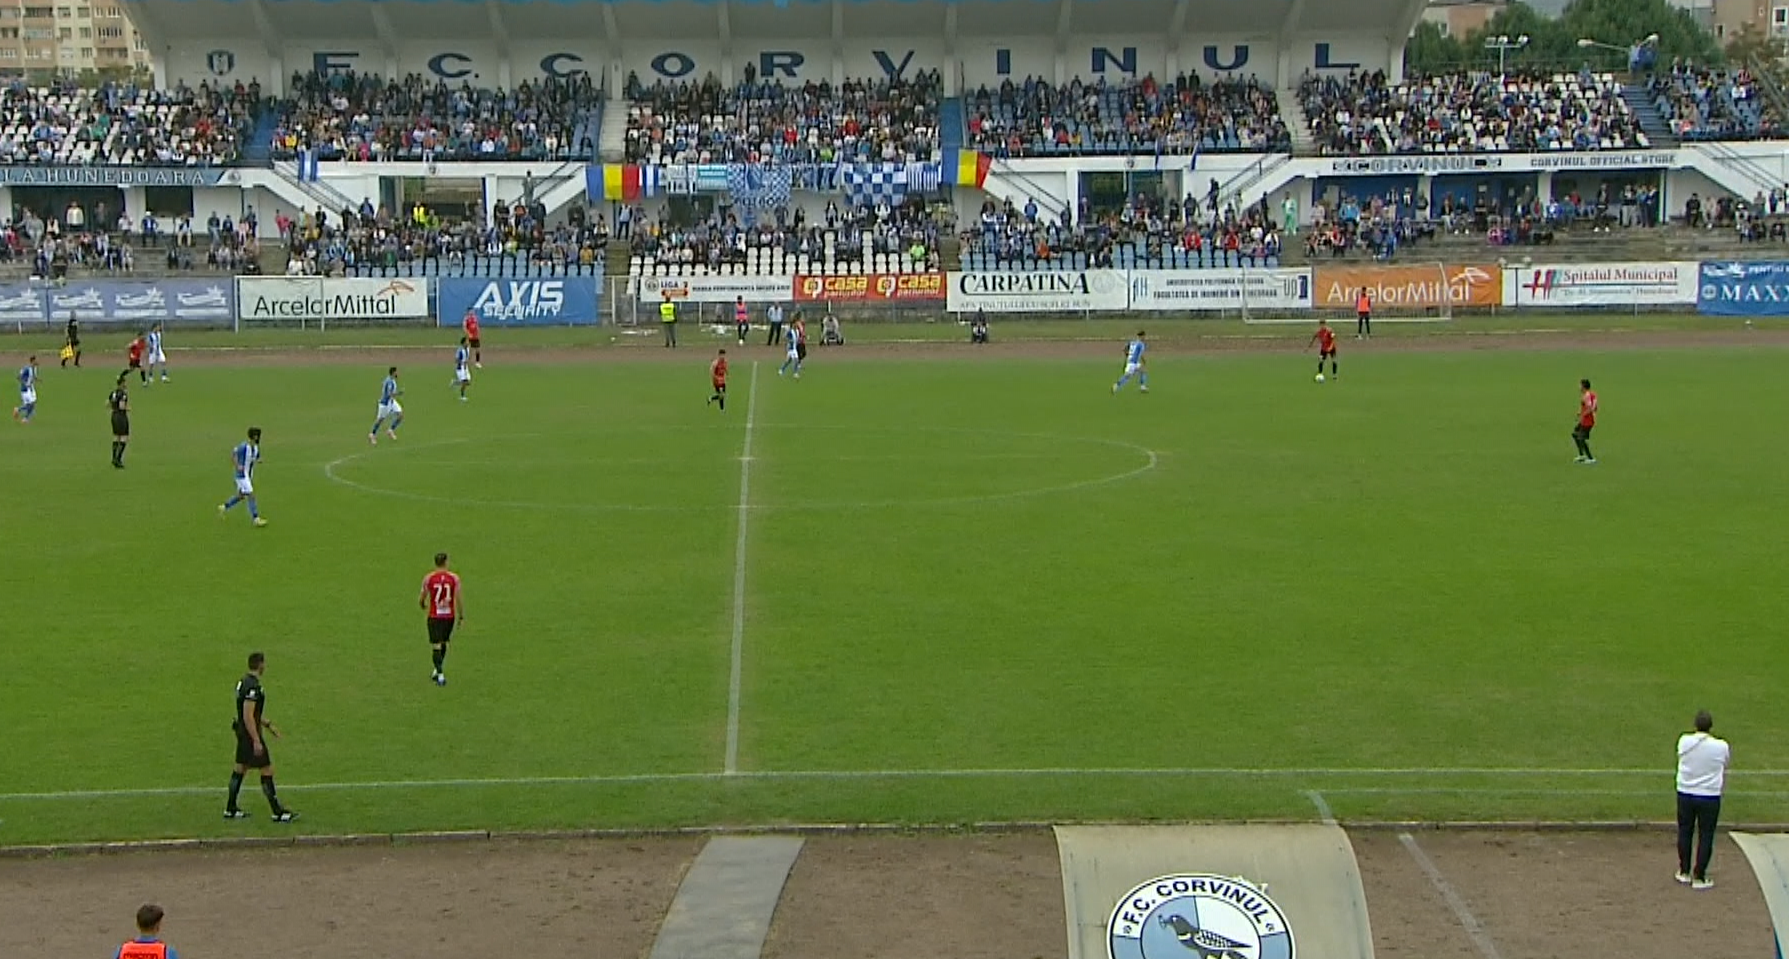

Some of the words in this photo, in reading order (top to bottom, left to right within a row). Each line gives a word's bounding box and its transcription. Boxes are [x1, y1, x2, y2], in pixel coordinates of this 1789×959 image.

[1352, 156, 1487, 173] CORVINUL
[1531, 156, 1586, 167] CORVINUL
[1590, 155, 1637, 166] OFFICIAL
[47, 169, 204, 184] HUNEDOARA
[825, 276, 868, 290] casa
[899, 275, 941, 289] casa
[960, 273, 1090, 294] CARPATINA
[1564, 269, 1611, 284] Spitalul
[1614, 267, 1678, 284] Municipal
[473, 281, 564, 311] AXIS
[254, 294, 396, 316] ArcelorMittal
[433, 583, 452, 602] 71
[1156, 879, 1269, 925] CORVINUL
